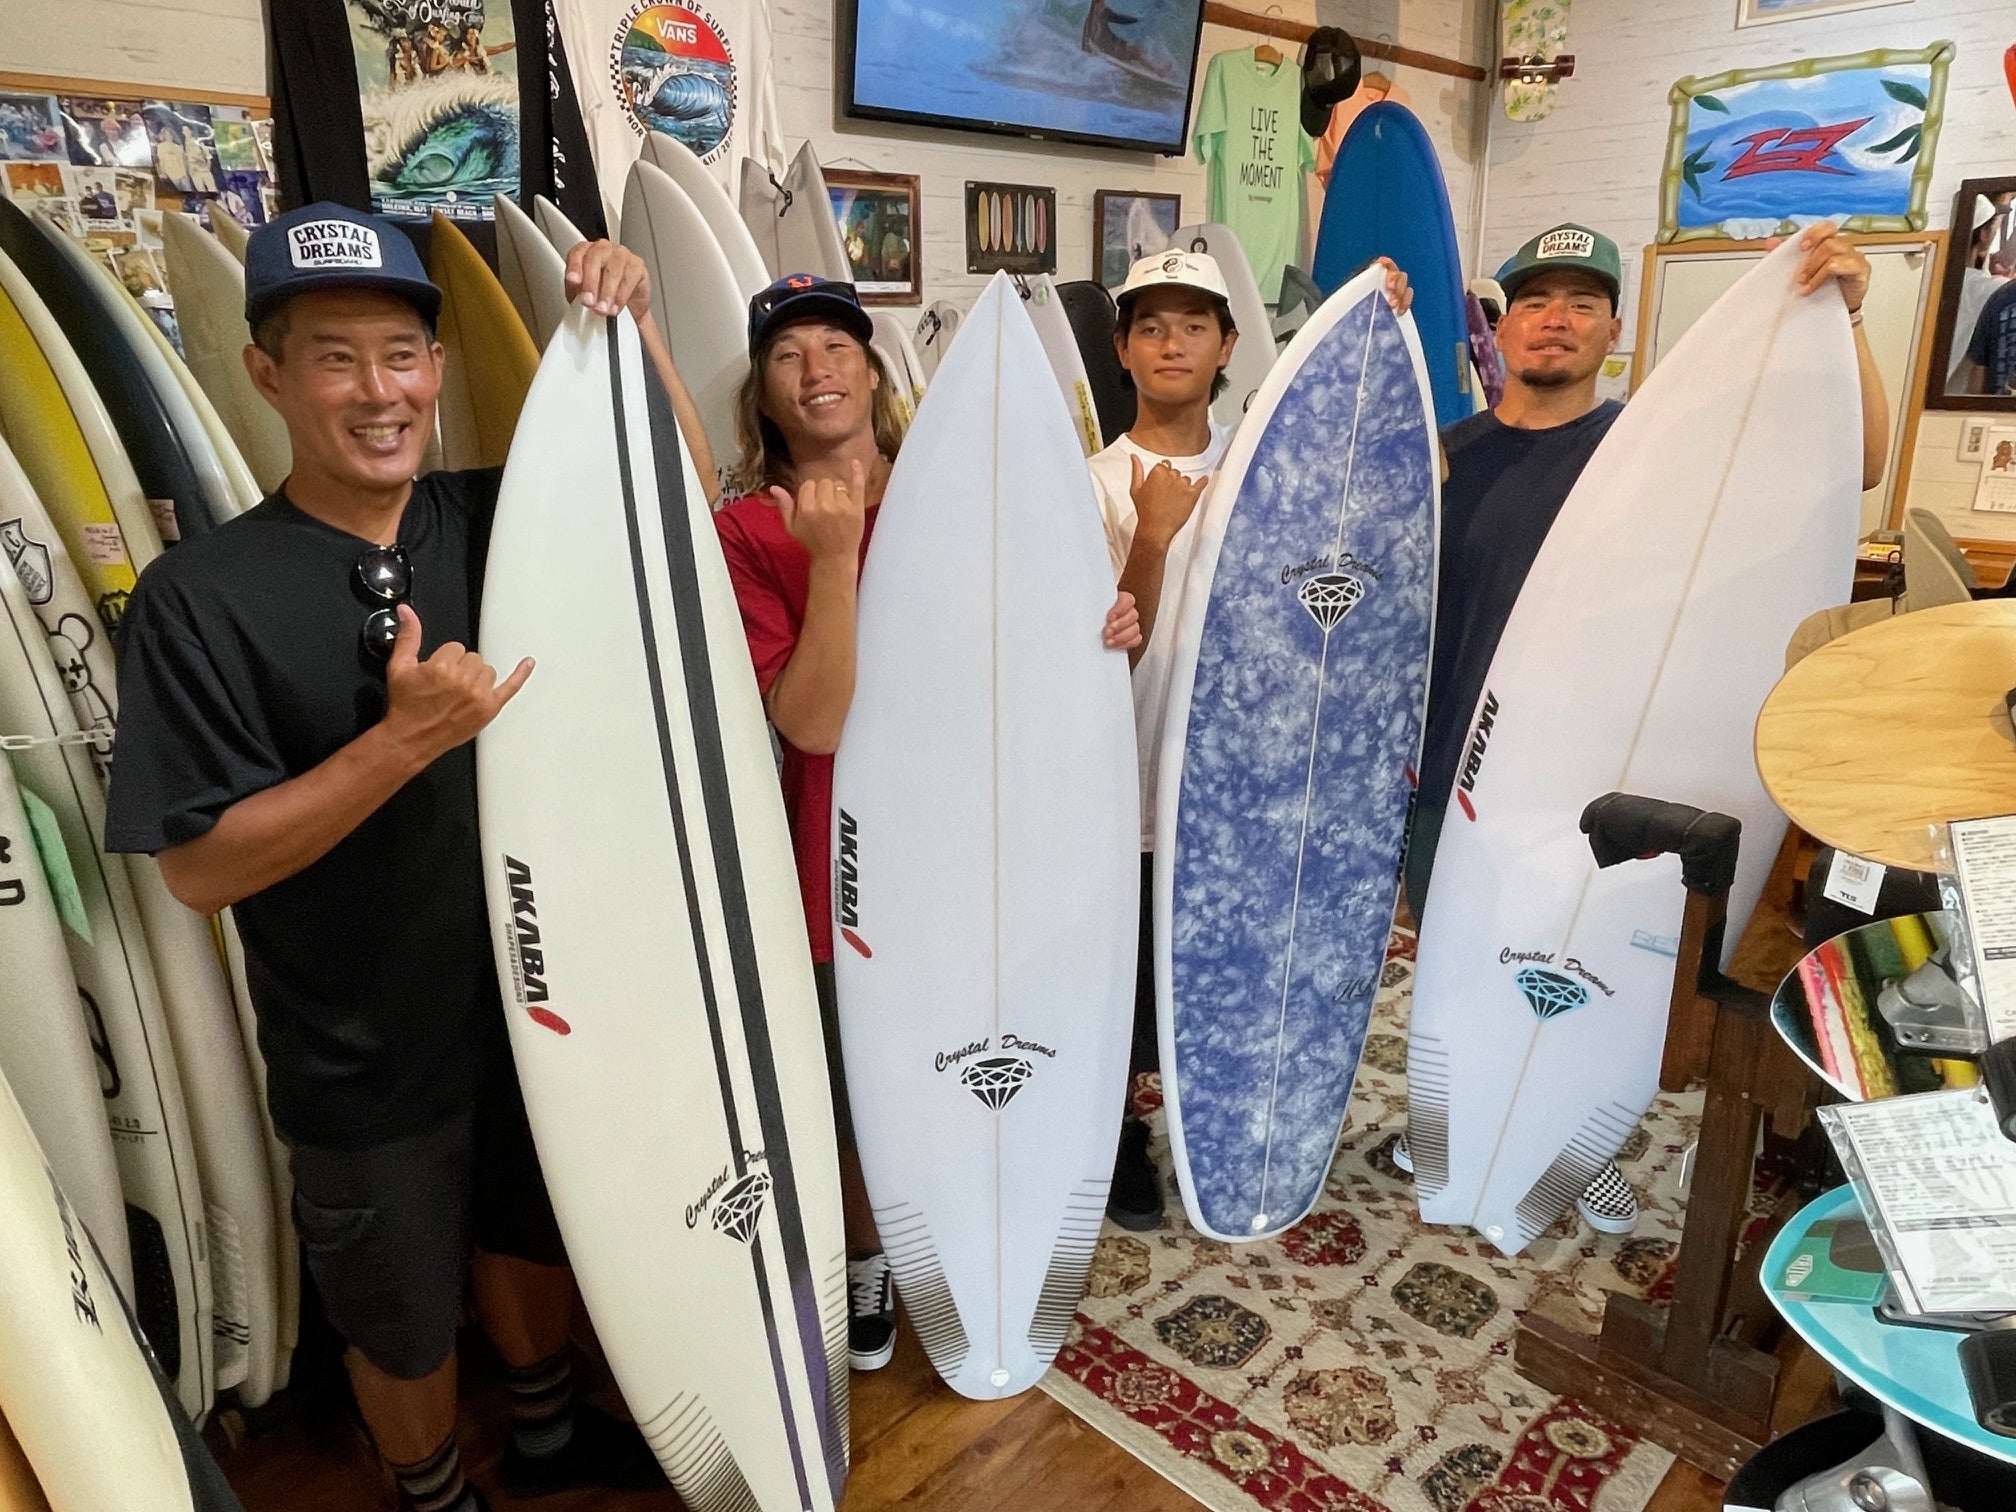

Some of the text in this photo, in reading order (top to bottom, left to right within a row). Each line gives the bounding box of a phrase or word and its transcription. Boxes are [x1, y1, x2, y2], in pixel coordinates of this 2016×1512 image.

[611, 5, 641, 51] TRIPLE
[687, 0, 702, 14] OF
[704, 12, 737, 73] SURFING
[656, 17, 697, 44] VANS
[1250, 106, 1278, 134] LIVE
[1252, 135, 1275, 161] THE
[1239, 162, 1284, 190] MOMENT
[293, 224, 373, 246] CRYSTAL
[1543, 231, 1590, 245] CRYSTAL
[1543, 242, 1587, 254] DREAMS
[299, 242, 373, 260] DREAMS
[1281, 552, 1384, 585] Crystal Dreams
[1460, 688, 1500, 793] AKABA
[840, 808, 858, 928] AKABA
[505, 854, 550, 1003] AKABA
[1499, 946, 1616, 998] Crystal Dreams
[935, 1033, 1057, 1072] Crystal Dreams
[685, 1164, 731, 1230] Crystal
